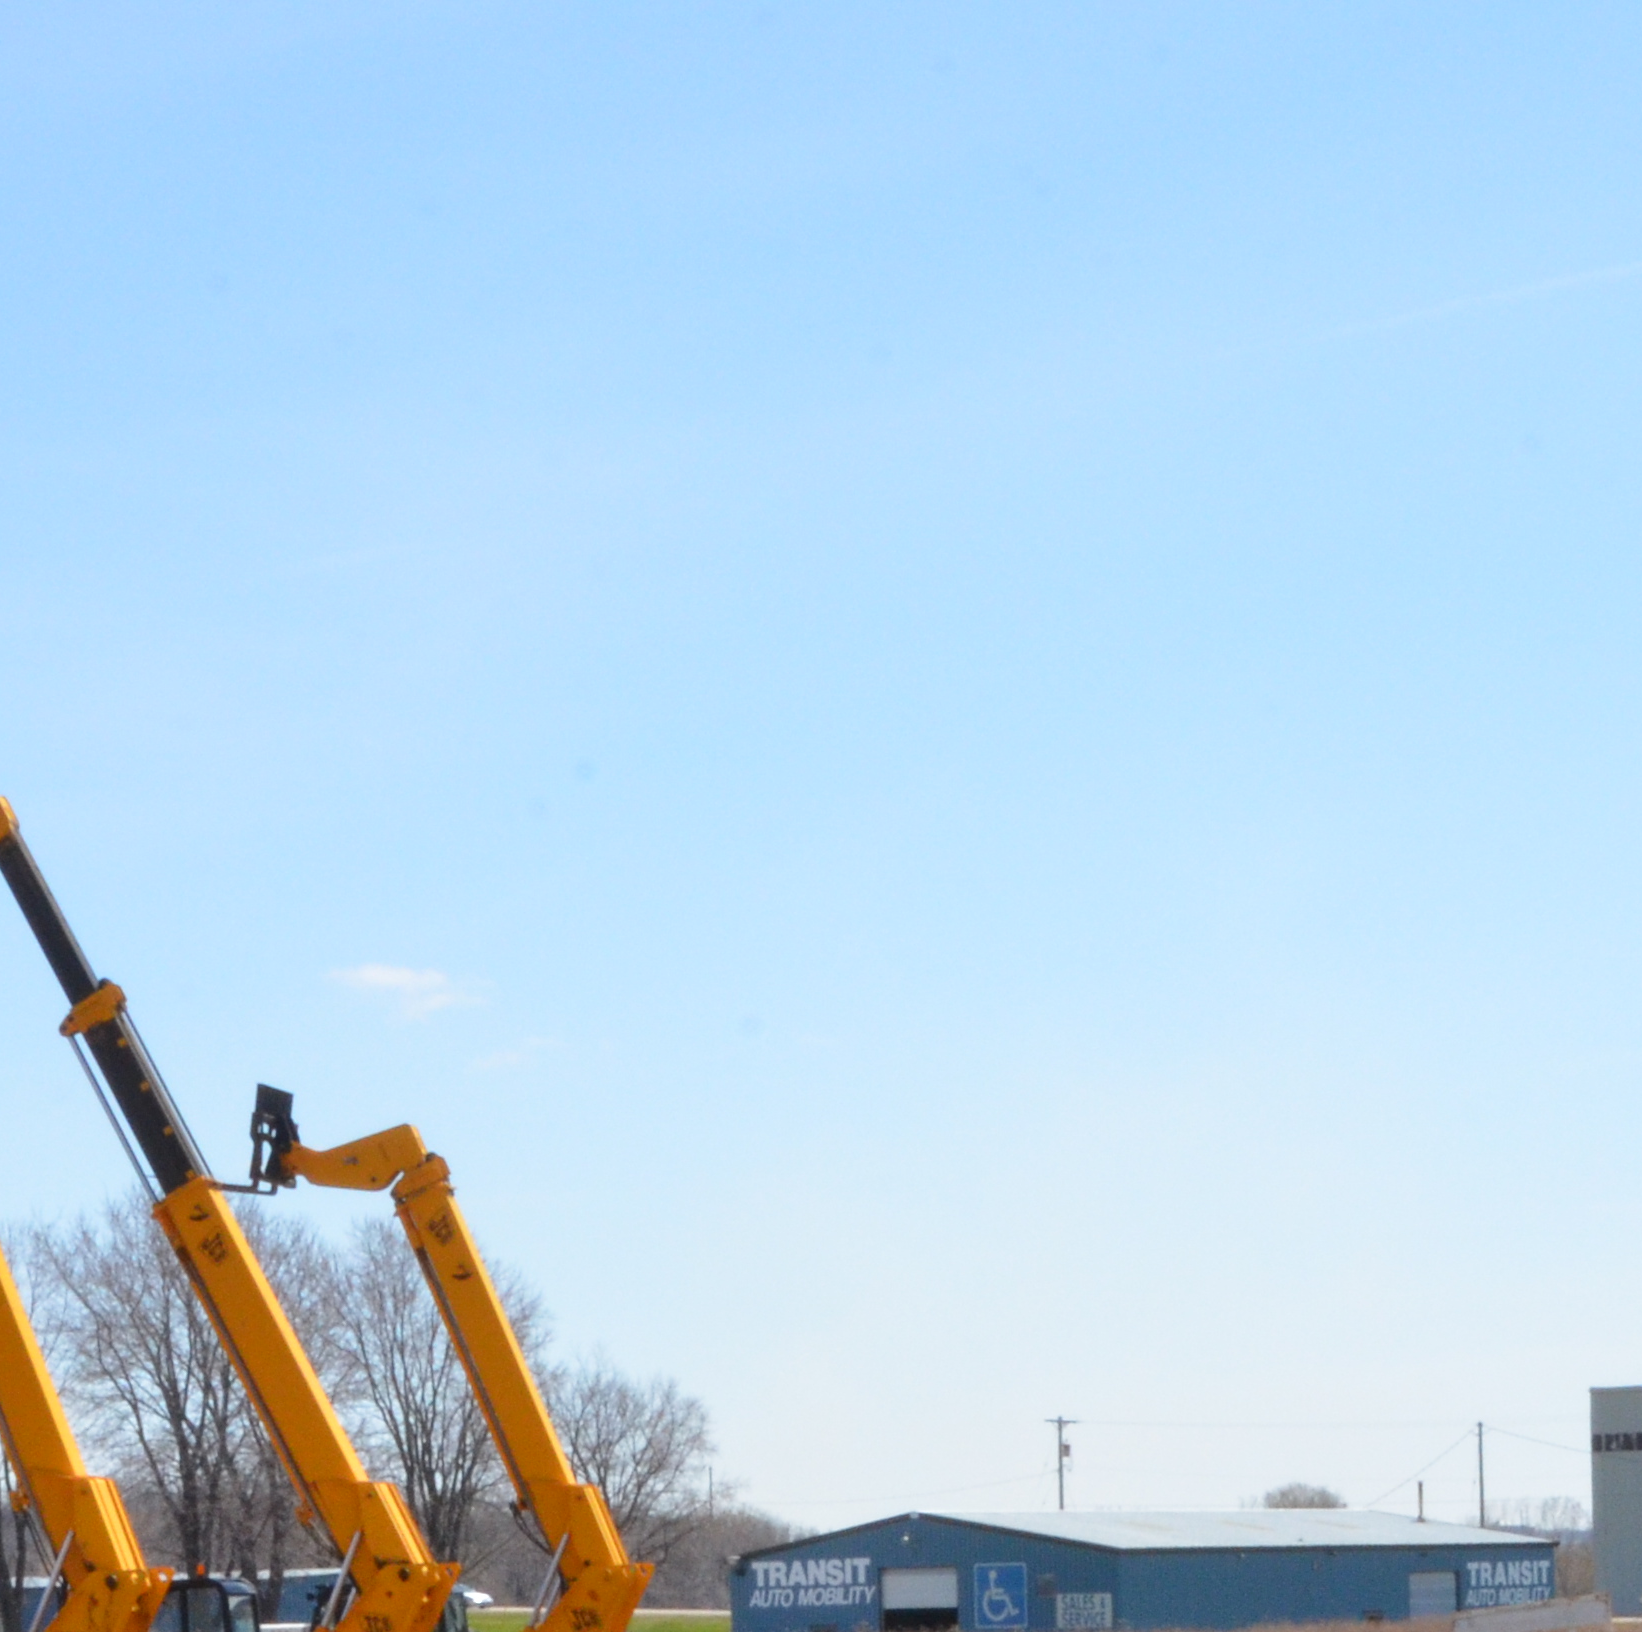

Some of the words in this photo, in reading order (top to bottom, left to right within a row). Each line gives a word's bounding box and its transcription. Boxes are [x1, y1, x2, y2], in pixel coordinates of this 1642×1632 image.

[750, 1556, 871, 1587] TRANSIT
[1465, 1560, 1551, 1587] TRANSIT
[748, 1587, 795, 1608] AUTO
[797, 1584, 877, 1607] MOBILITY
[1061, 1593, 1095, 1610] SALES
[1465, 1588, 1496, 1606] AUTO
[1498, 1586, 1551, 1606] MOBILITY
[1061, 1611, 1107, 1629] SERVICE
